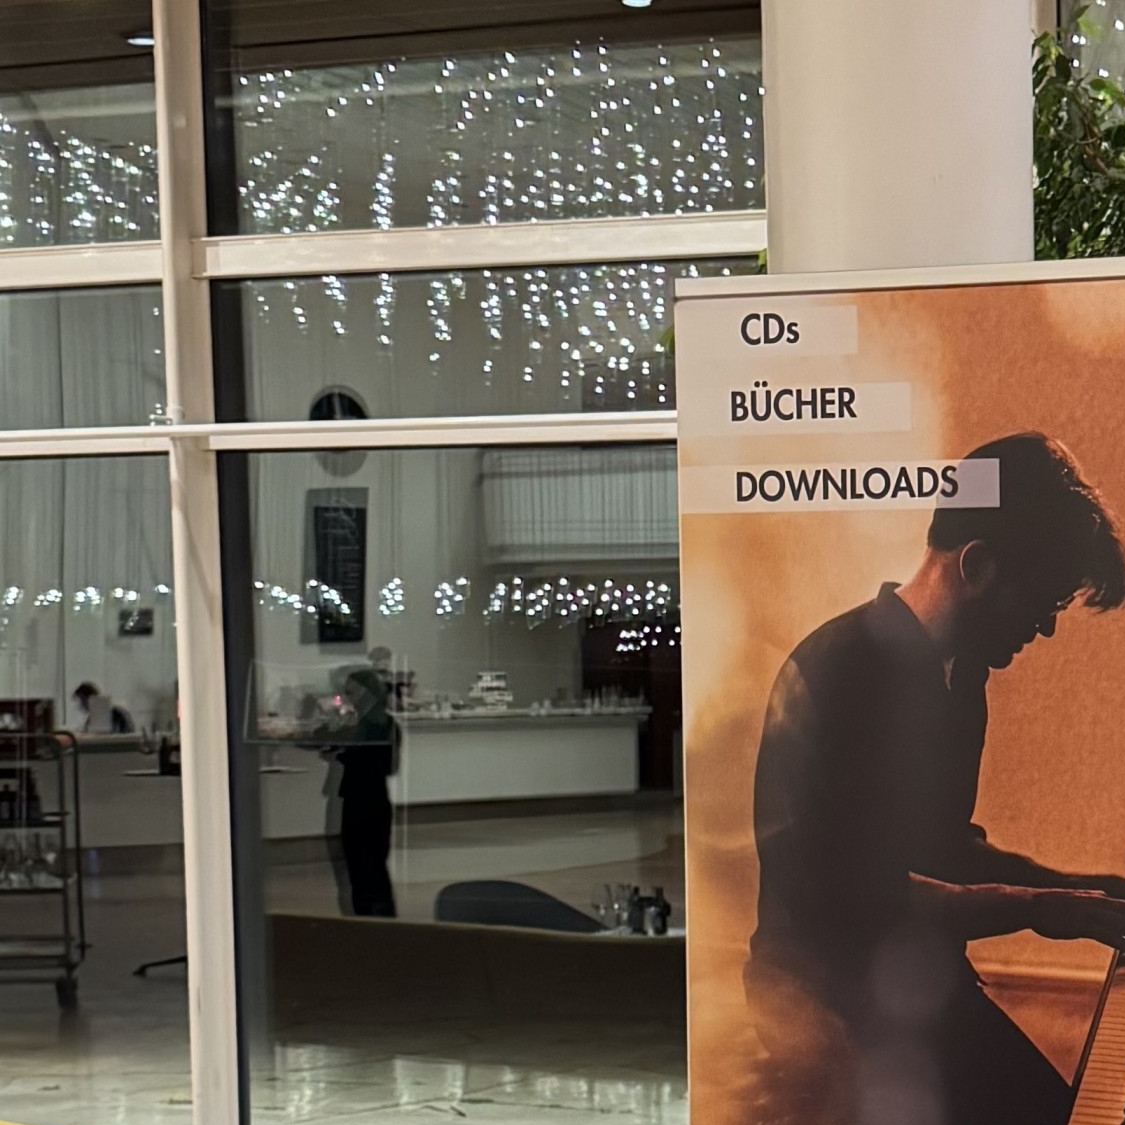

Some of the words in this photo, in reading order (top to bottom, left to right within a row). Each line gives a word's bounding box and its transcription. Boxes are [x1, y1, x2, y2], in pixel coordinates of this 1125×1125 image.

[741, 313, 800, 345] CDs
[731, 381, 857, 421] BÜCHER
[736, 466, 959, 501] DOWNLOADS
